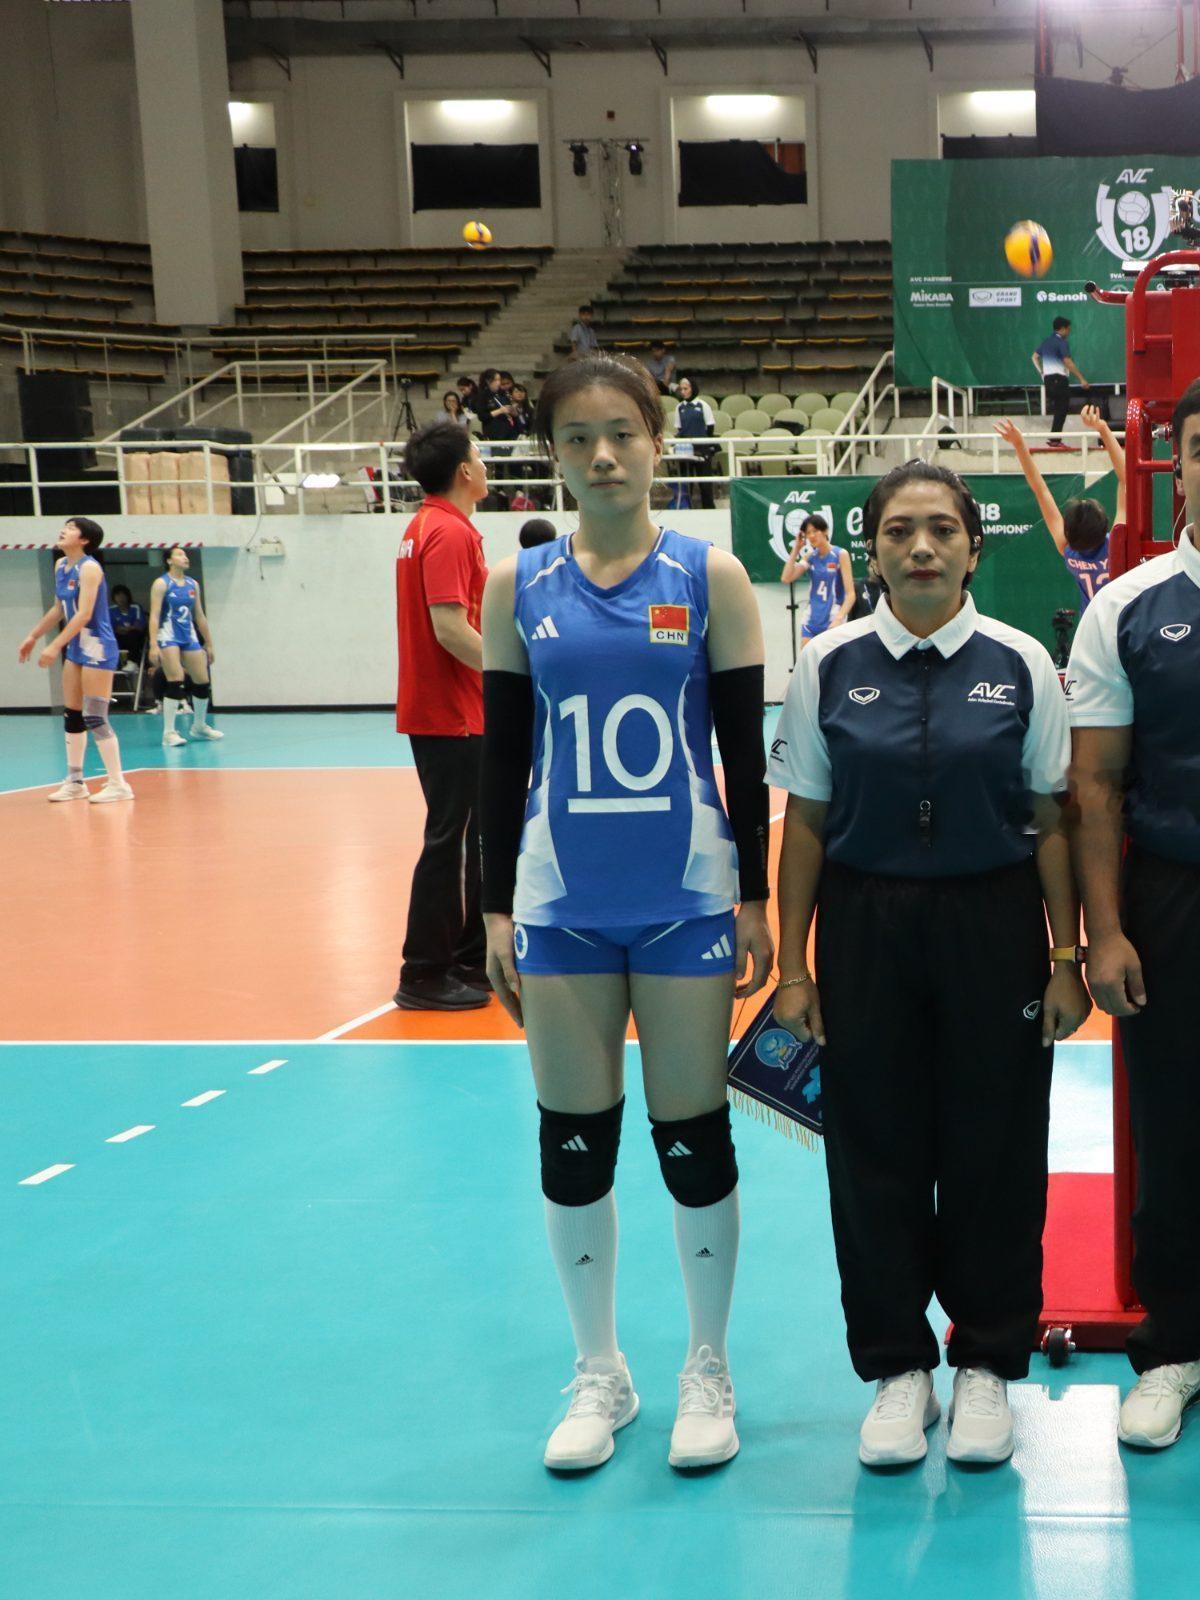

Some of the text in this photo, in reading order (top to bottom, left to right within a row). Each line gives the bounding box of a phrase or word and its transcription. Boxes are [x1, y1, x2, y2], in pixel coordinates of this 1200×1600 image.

[1115, 168, 1154, 184] AVC
[1121, 226, 1151, 253] 18
[1048, 292, 1088, 302] Senoh
[784, 490, 816, 504] AVC
[979, 503, 1001, 521] 18
[817, 580, 828, 602] 4
[177, 605, 189, 623] 2
[656, 630, 685, 641] CHN
[968, 682, 1016, 700] AVC
[558, 694, 674, 792] 10
